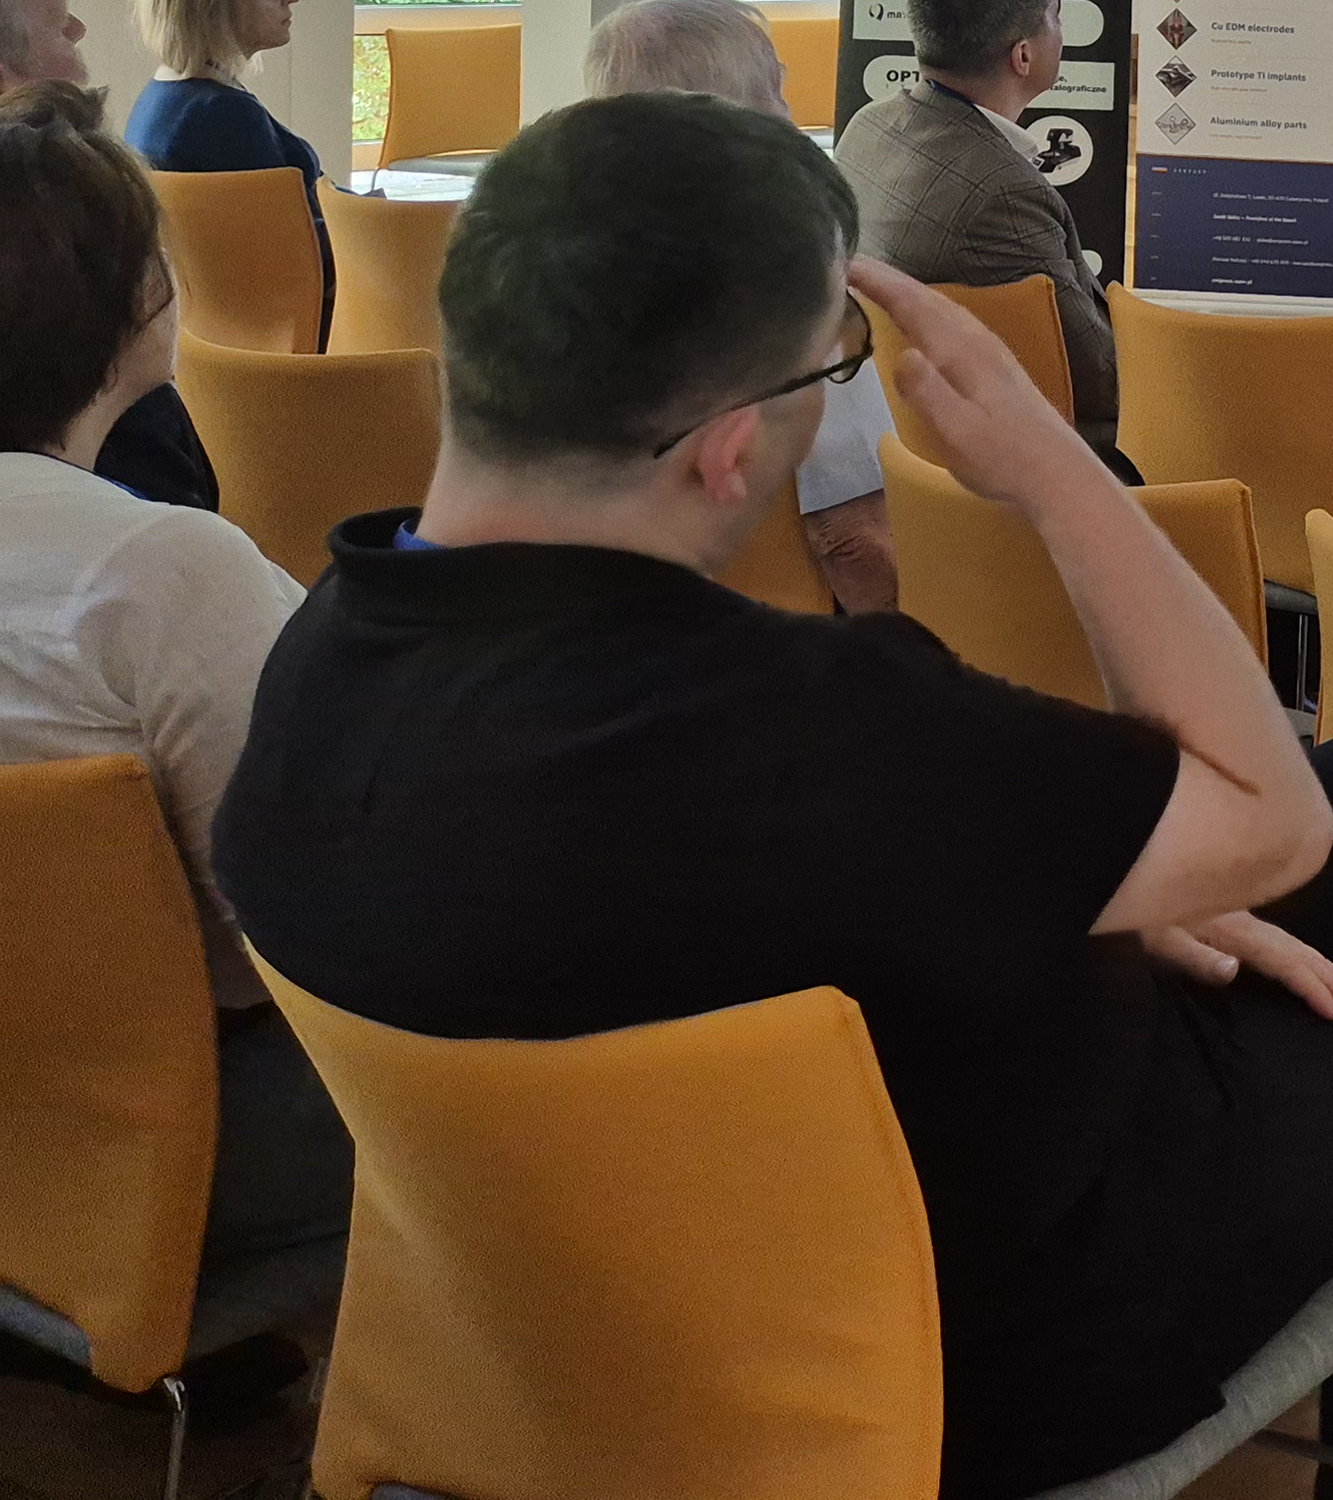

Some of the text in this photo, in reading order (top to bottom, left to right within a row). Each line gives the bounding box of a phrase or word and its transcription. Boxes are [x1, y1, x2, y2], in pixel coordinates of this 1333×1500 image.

[1211, 22, 1295, 34] Cu EDM electrodes
[1211, 70, 1255, 81] Prototype
[1267, 72, 1306, 82] implants
[1050, 84, 1107, 93] alograficzne
[1210, 117, 1307, 130] Aluminium alloy parts
